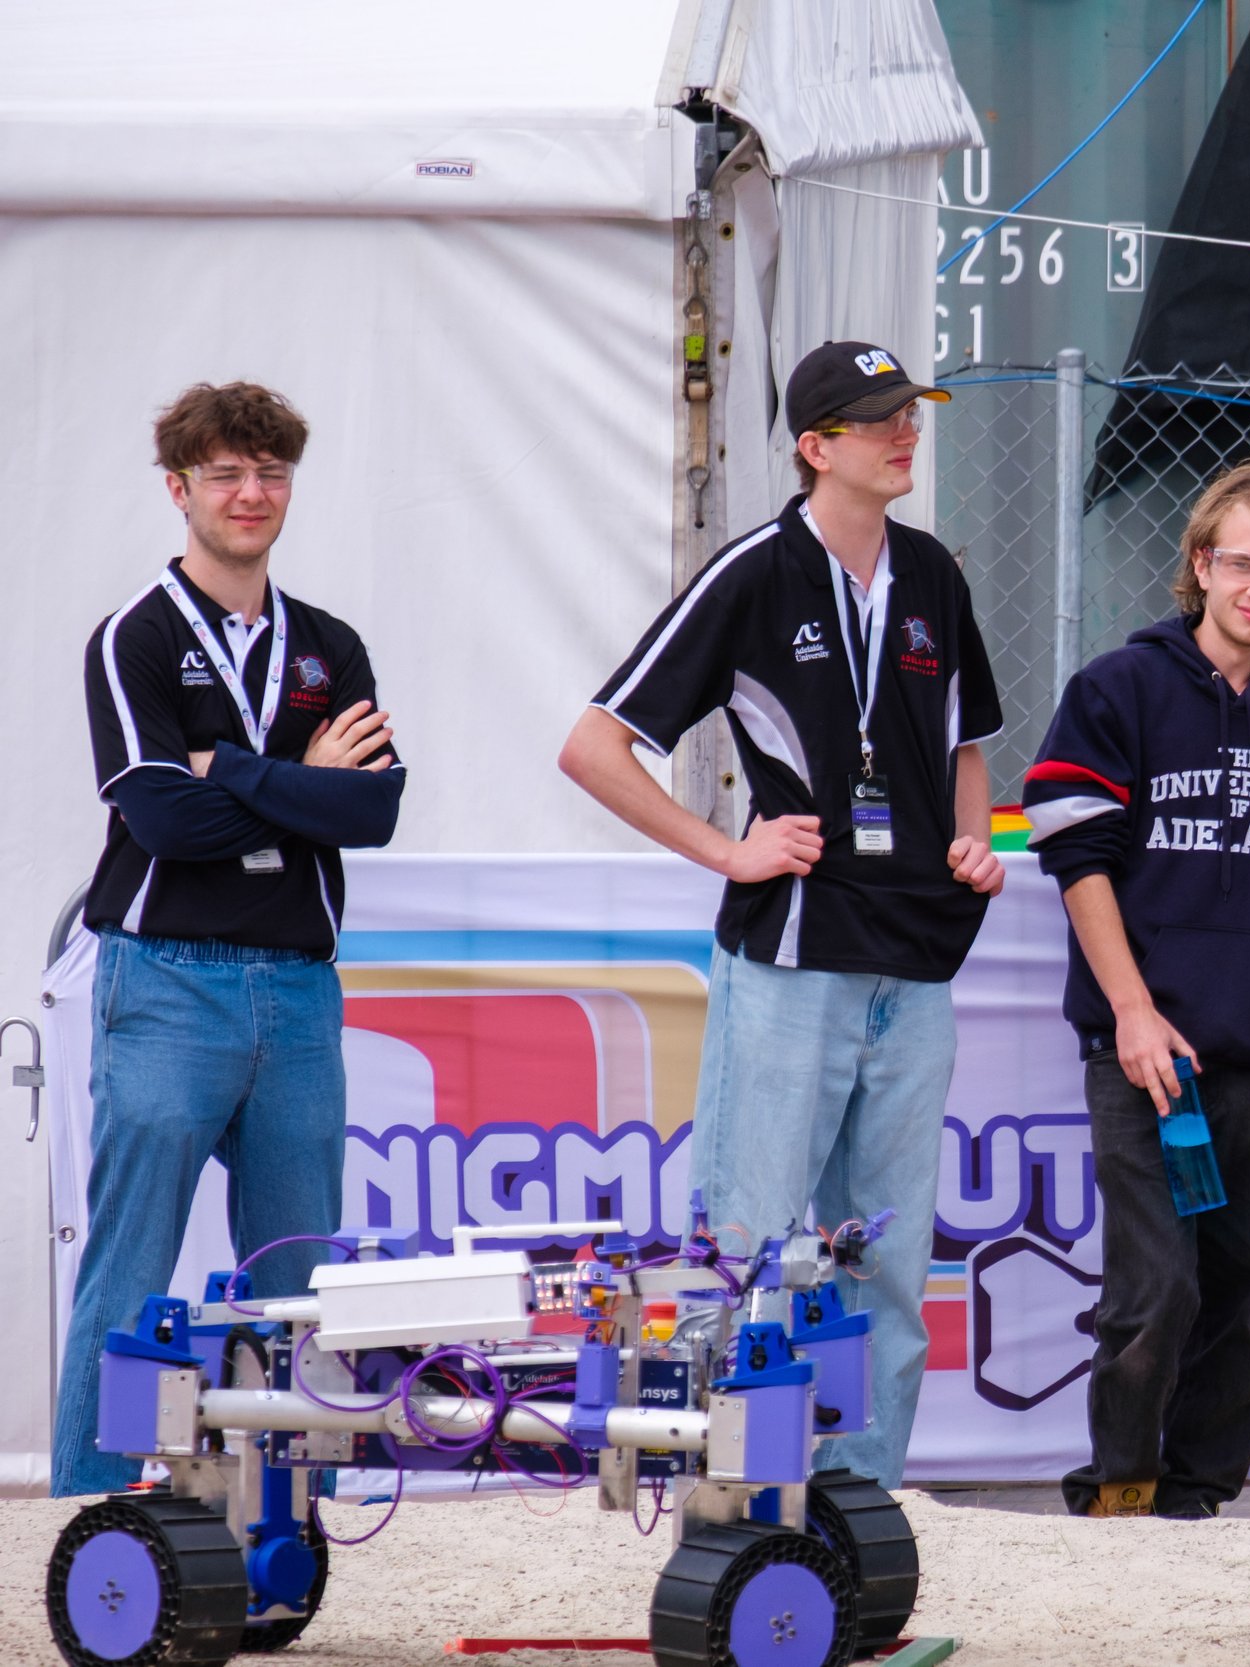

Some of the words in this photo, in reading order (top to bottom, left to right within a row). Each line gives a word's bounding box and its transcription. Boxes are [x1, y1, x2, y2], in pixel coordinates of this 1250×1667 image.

[419, 166, 470, 175] ROBIAN
[1114, 231, 1138, 286] 3
[854, 350, 897, 376] CAT
[795, 643, 824, 655] Adelaide
[795, 651, 830, 662] University
[182, 670, 209, 678] Adelaide
[182, 678, 214, 686] University
